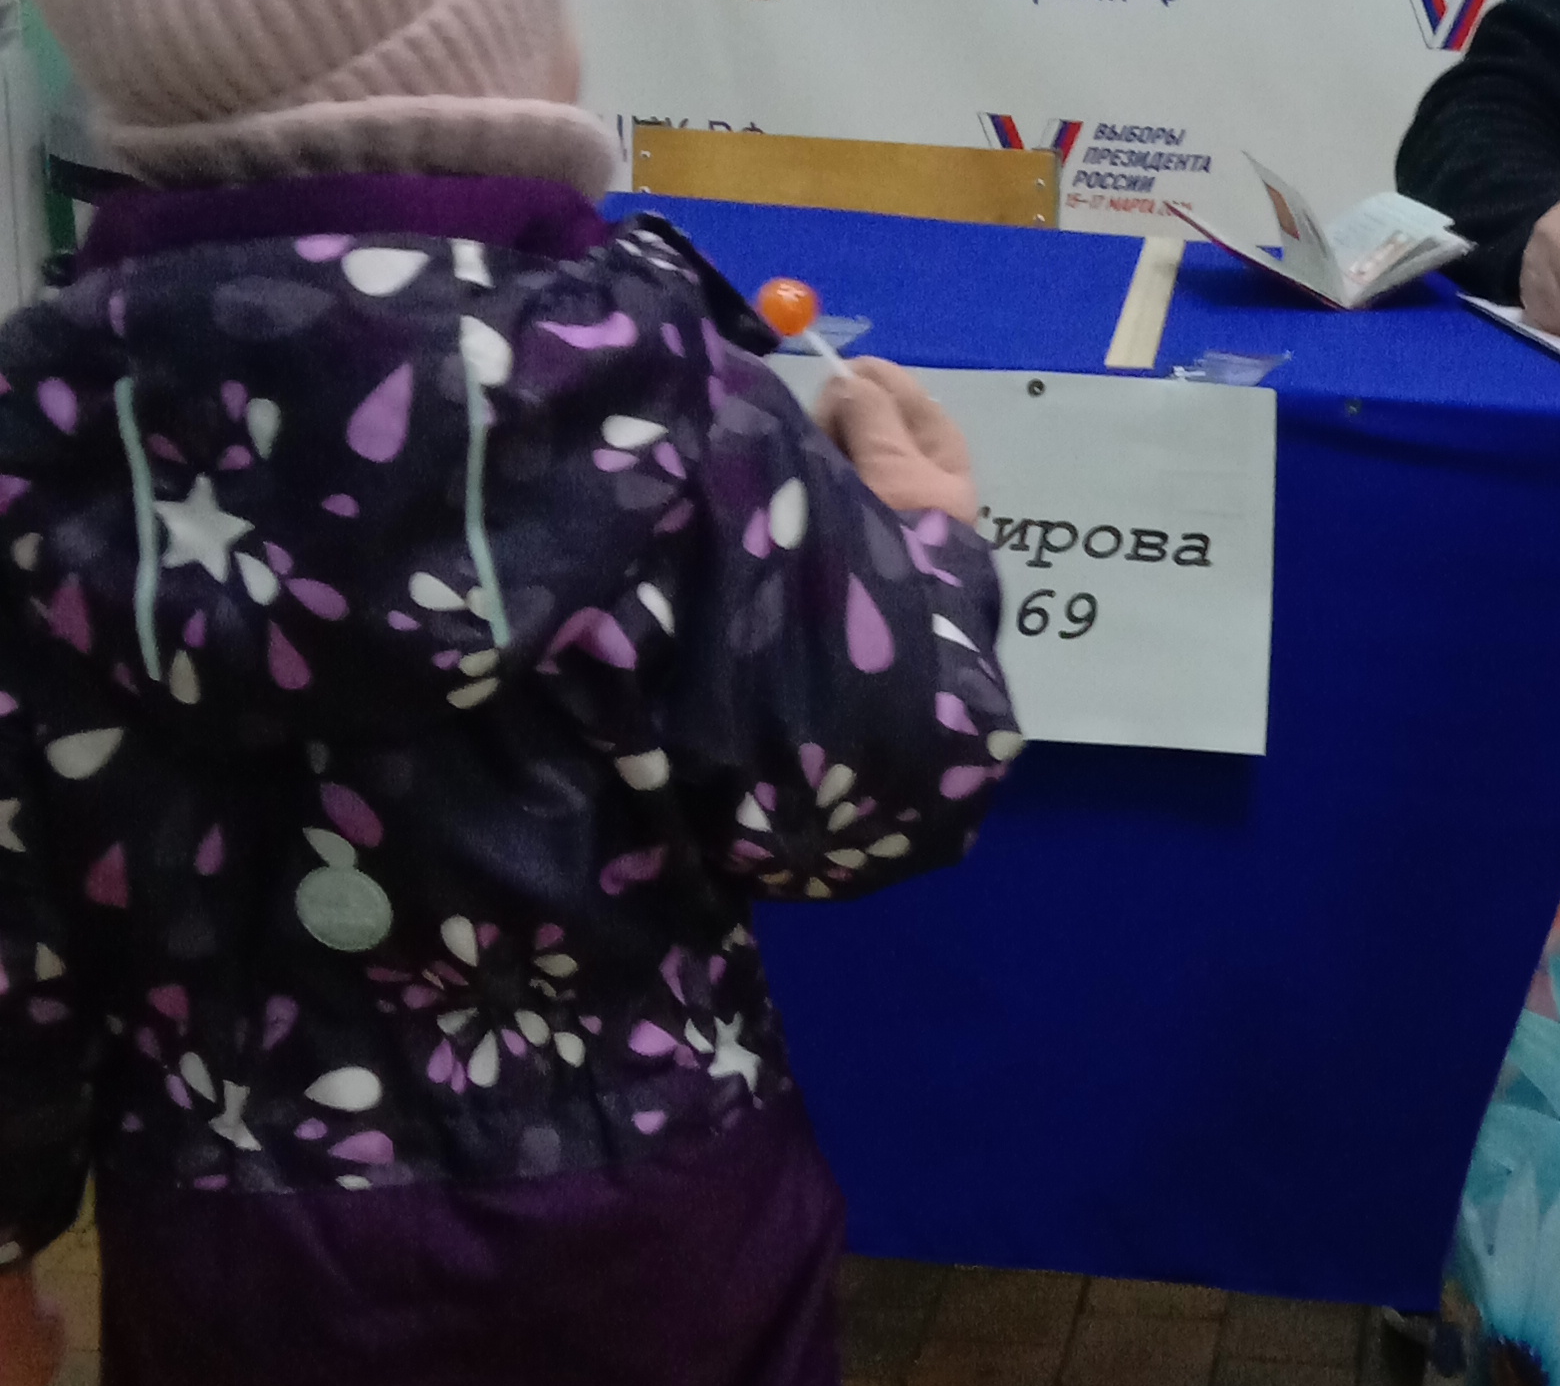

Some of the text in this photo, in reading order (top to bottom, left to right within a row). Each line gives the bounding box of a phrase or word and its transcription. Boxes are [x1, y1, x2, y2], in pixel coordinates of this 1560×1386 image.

[1093, 122, 1187, 146] ВЫБОРЫ
[1083, 147, 1212, 173] ПРЕЗИДЕНТА
[1072, 170, 1156, 193] РОССИИ
[978, 506, 1212, 569] ирова
[1015, 588, 1099, 640] 69
